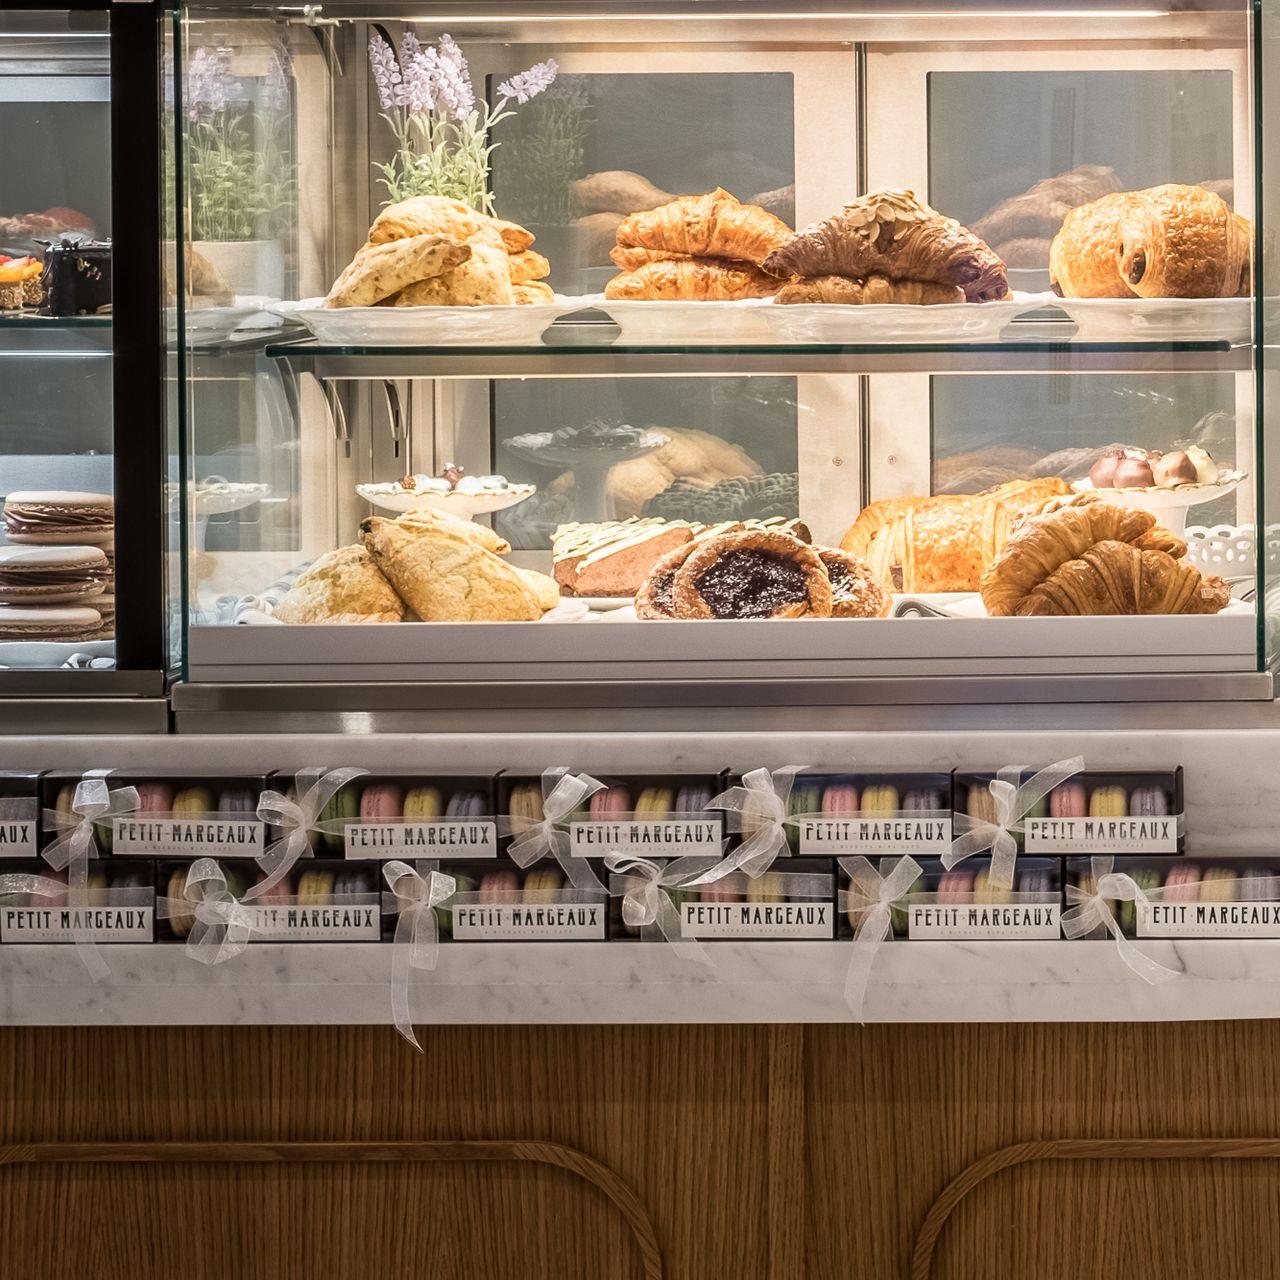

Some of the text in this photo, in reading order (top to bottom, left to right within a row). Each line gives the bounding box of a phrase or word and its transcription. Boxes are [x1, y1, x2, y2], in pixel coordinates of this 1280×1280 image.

[118, 823, 258, 844] PETIT MARGEAUX
[350, 826, 491, 847] PETIT MARGEAUX
[576, 824, 715, 844] PETIT MARGEAUX
[805, 822, 945, 841] PETIT MARGEAUX
[1030, 821, 1170, 840] PETIT MARGEAUX
[6, 910, 146, 930] PETIT MARGEAUX
[287, 909, 373, 928] MARGEAUX
[457, 907, 597, 927] PETIT MARGEAUX
[686, 906, 826, 925] PETIT MARGEAUX
[914, 907, 1053, 927] PETIT MARGEAUX
